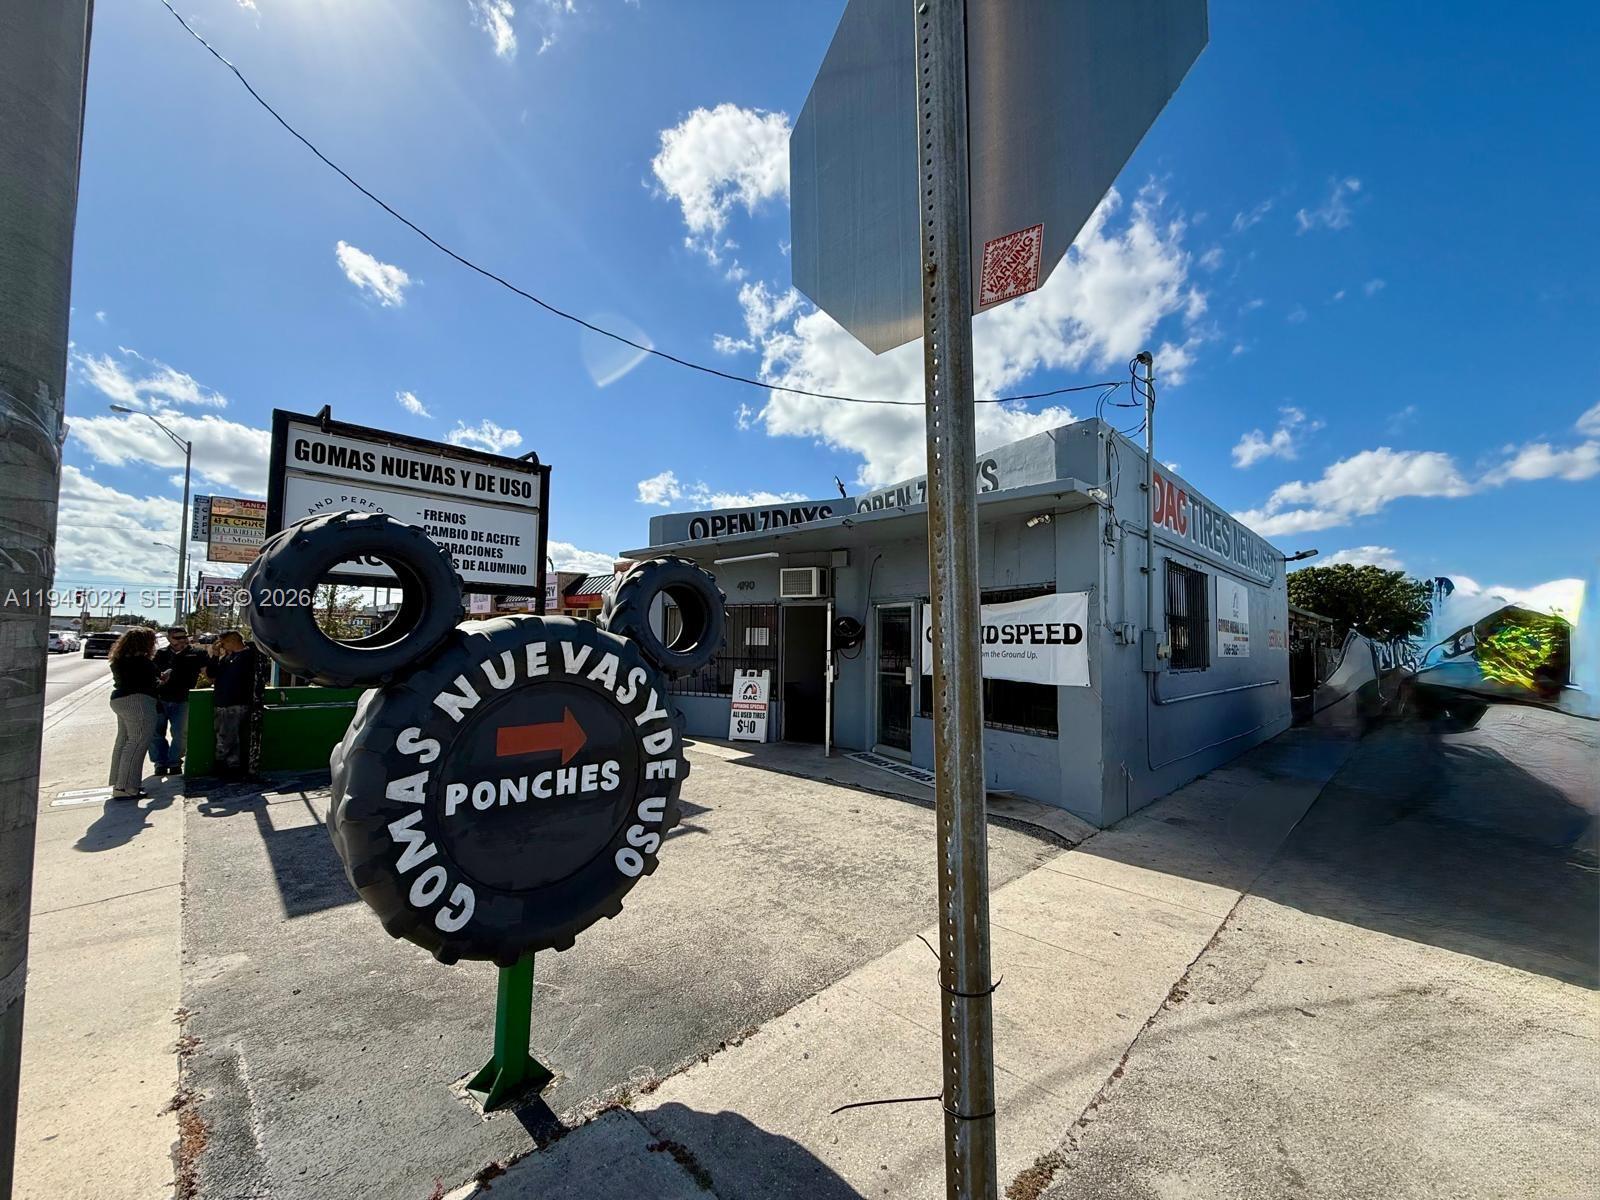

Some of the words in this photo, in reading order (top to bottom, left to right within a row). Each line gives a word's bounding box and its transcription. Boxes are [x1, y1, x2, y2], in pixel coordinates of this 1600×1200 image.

[986, 236, 1034, 293] WARNING
[294, 438, 376, 473] GOMAS
[381, 455, 456, 487] NUEVAS
[460, 469, 471, 489] Y
[475, 472, 496, 494] DE
[500, 476, 532, 499] USO
[307, 497, 333, 515] AND
[424, 509, 467, 525] FRENOS
[1153, 471, 1188, 537] DAC
[1187, 492, 1231, 560] TIRES
[424, 524, 469, 541] CAMBIO
[471, 530, 484, 542] DE
[486, 532, 521, 546] ACEITE
[689, 512, 756, 540] OPEN
[462, 559, 476, 571] DE
[477, 560, 527, 576] ALUMINIO
[991, 650, 1000, 658] the
[1001, 650, 1026, 659] Ground
[1026, 651, 1038, 660] Up.
[433, 641, 647, 723] NUEVAS
[634, 687, 668, 726] Y
[741, 711, 752, 719] USED
[753, 712, 766, 720] TIRES
[737, 719, 756, 734] $40
[642, 727, 677, 780] DE
[445, 760, 620, 816] PONCHES
[386, 727, 476, 932] GOMAS
[615, 797, 667, 878] USO
